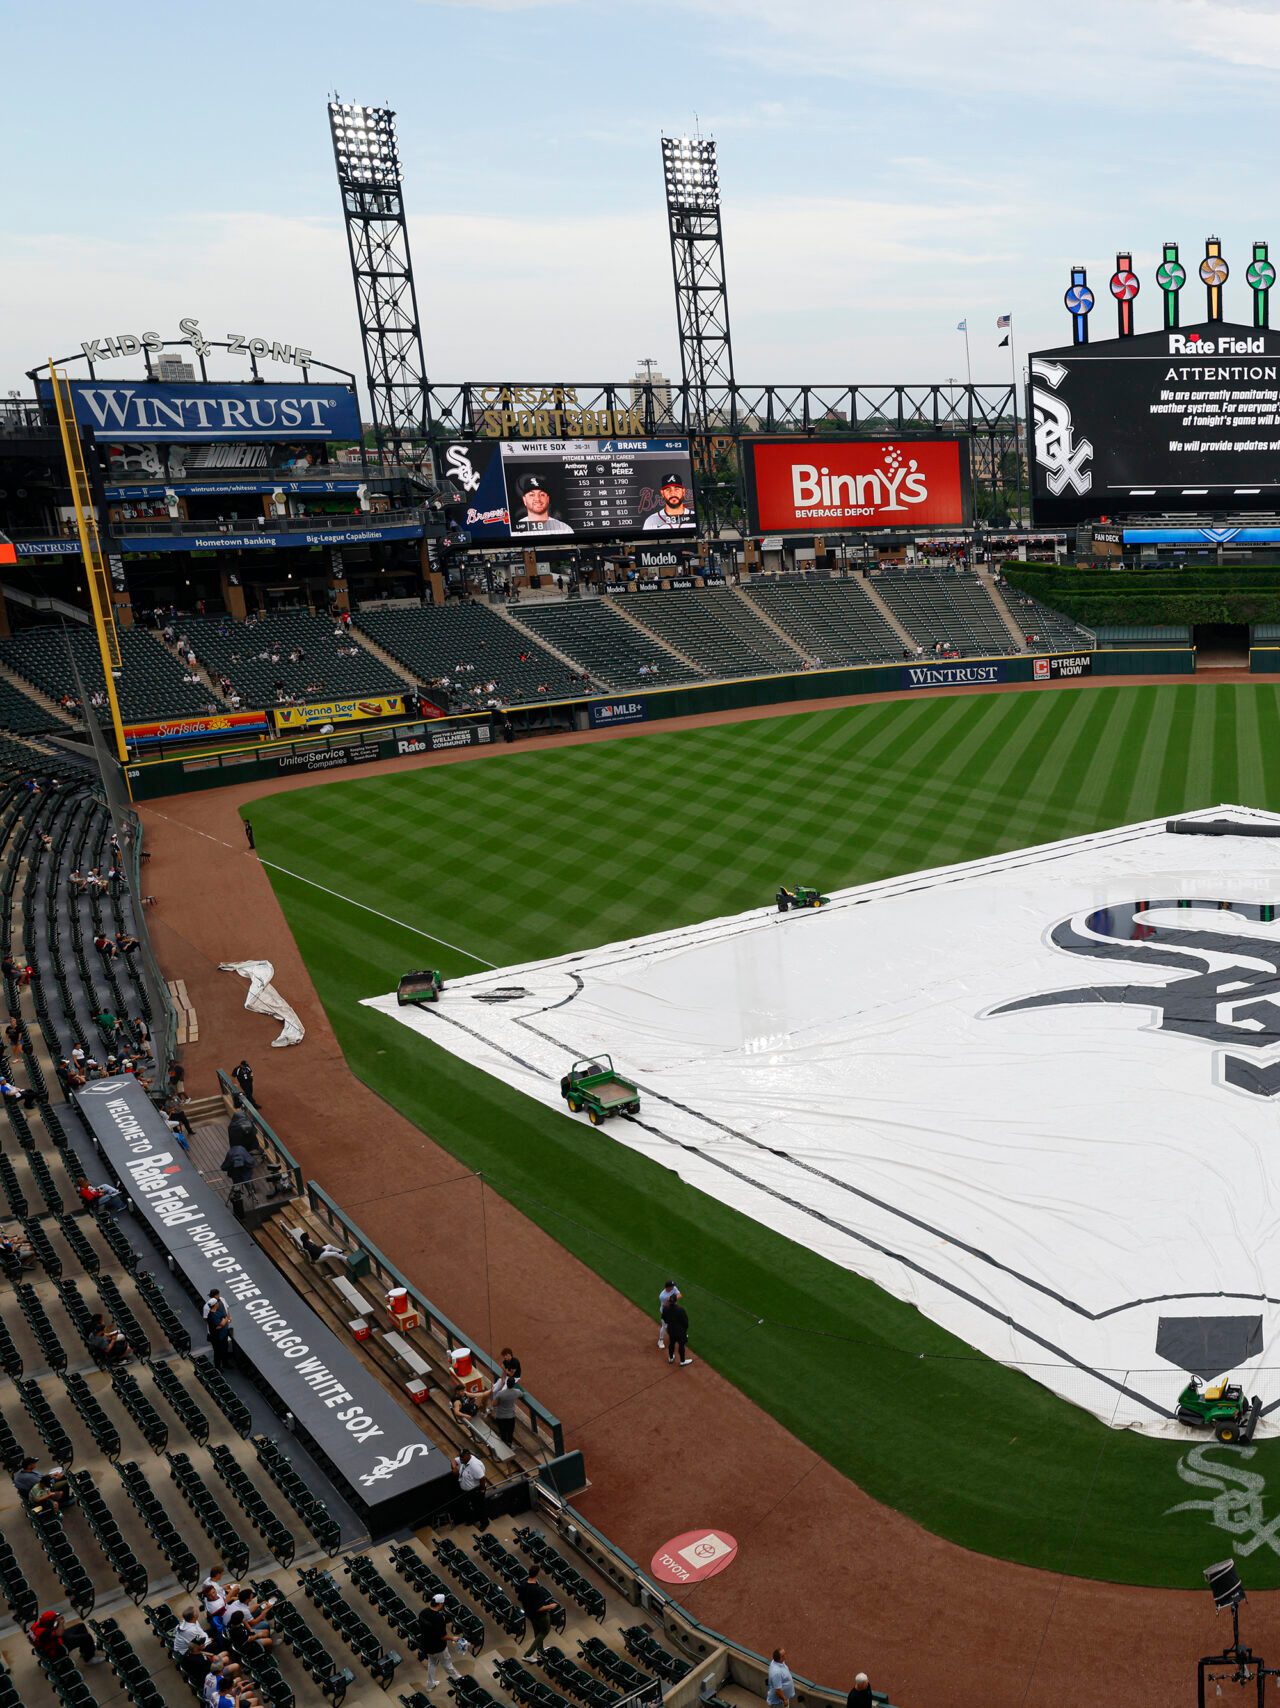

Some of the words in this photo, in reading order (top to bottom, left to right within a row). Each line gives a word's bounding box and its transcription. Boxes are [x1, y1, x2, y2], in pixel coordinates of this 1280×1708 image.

[81, 331, 164, 362] KIDS
[227, 334, 312, 368] ZONE
[1168, 334, 1215, 354] Rate
[1218, 337, 1265, 354] Field
[1165, 367, 1277, 381] ATTENTION
[481, 387, 578, 404] CAESARS
[1161, 390, 1174, 400] We
[1175, 391, 1190, 400] are
[1191, 389, 1231, 401] currently
[1232, 389, 1278, 401] monitoring
[78, 389, 332, 428] WINTRUST
[1150, 403, 1187, 413] weather
[1187, 403, 1221, 414] system.
[1222, 402, 1237, 412] For
[483, 409, 645, 437] SPORTSBOOK
[1183, 415, 1193, 426] of
[1193, 415, 1232, 427] tonight's
[1233, 416, 1256, 427] game
[1257, 414, 1274, 425] will
[522, 443, 548, 452] WHITE
[550, 442, 566, 452] SOX
[617, 442, 648, 450] BRAVES
[1169, 441, 1183, 451] We
[1184, 440, 1200, 451] will
[1200, 440, 1233, 452] provide
[1233, 440, 1268, 452] updates
[565, 463, 588, 471] Anthony
[191, 485, 257, 493] wintrust.com/whitesox
[796, 509, 843, 518] BEVERAGE
[845, 508, 874, 516] DEPOT
[532, 522, 544, 531] 18
[665, 516, 677, 524] 33
[195, 539, 241, 547] Hometown
[242, 537, 277, 547] Banking
[306, 534, 342, 543] Big-League
[344, 531, 382, 541] Capabilities
[1094, 533, 1105, 541] FAN
[1105, 534, 1120, 543] DECK
[16, 542, 80, 553] WINTRUST
[641, 552, 677, 566] Modelo
[639, 583, 658, 591] Modelo
[707, 578, 726, 586] Modelo
[1051, 657, 1090, 668] STREAM
[909, 666, 998, 684] WINTRUST
[1060, 666, 1082, 676] NOW
[297, 705, 332, 717] Vienna
[334, 702, 357, 713] Beef
[613, 703, 642, 715] MLB+
[157, 722, 206, 738] Surfside
[433, 734, 471, 743] WELLNESS
[433, 739, 471, 748] COMMUNITY
[398, 739, 426, 753] Rate
[279, 749, 345, 766] UnitedService
[307, 757, 347, 769] Companies
[128, 770, 140, 778] 330
[105, 1098, 145, 1141] WELCOME
[129, 1138, 153, 1153] TO
[126, 1152, 176, 1192] Rate
[145, 1185, 205, 1227] Field
[186, 1223, 231, 1258] HOME
[212, 1253, 242, 1276] OF
[225, 1271, 261, 1301] THE
[245, 1298, 309, 1359] CHICAGO
[294, 1355, 354, 1408] WHITE
[336, 1406, 385, 1444] SOX
[659, 1554, 690, 1581] TOYOTA
